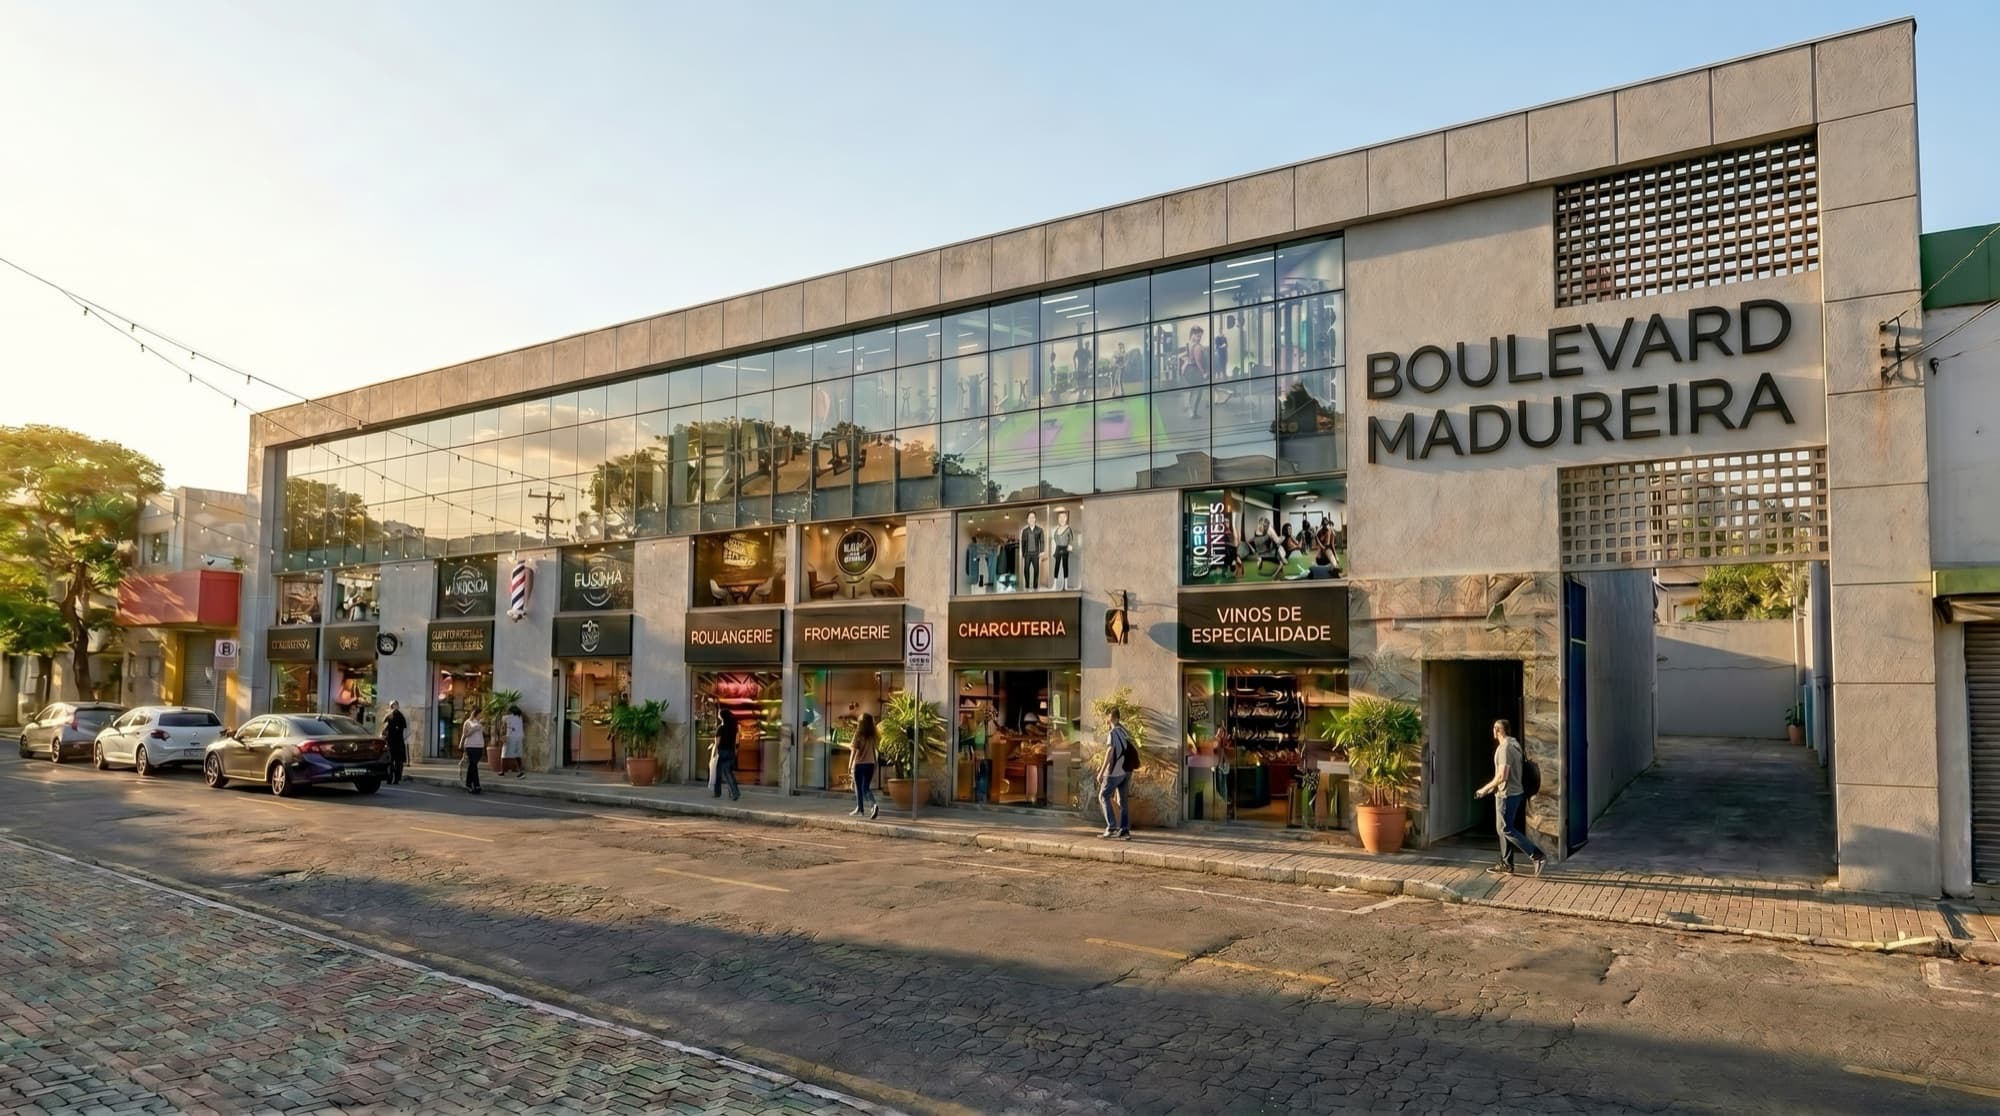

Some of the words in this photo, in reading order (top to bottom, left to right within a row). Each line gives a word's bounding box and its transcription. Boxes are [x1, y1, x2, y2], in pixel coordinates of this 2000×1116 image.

[1367, 299, 1792, 400] BOULEVARD
[1367, 372, 1796, 464] MADUREIRA
[1216, 607, 1272, 623] VINOS
[1278, 606, 1302, 622] DE
[804, 625, 891, 641] FROMAGERIE
[959, 620, 1066, 637] CHARCUTERIA
[1191, 625, 1331, 643] ESPECIALIDADE
